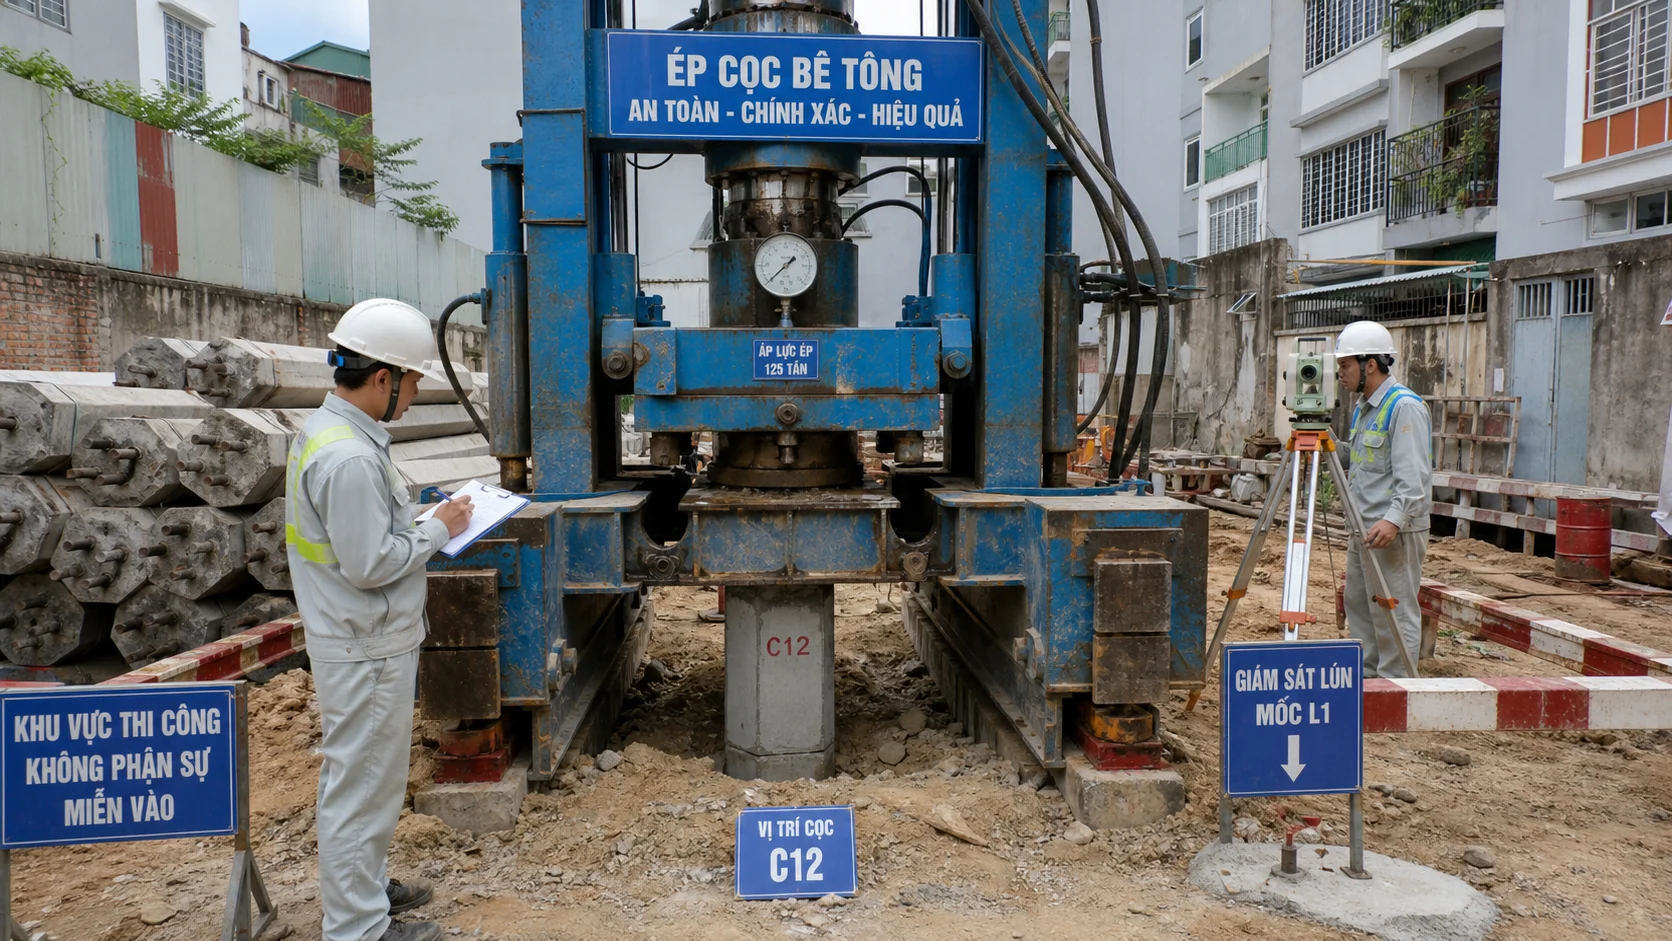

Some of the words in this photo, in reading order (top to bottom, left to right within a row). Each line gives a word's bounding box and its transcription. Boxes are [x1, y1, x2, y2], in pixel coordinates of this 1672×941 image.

[667, 46, 707, 87] ÉP
[718, 54, 781, 94] CỌC
[792, 50, 831, 90] BÊ
[841, 50, 922, 92] TÔNG
[628, 98, 658, 122] AN
[664, 94, 719, 124] TOÀN
[741, 96, 804, 125] CHÍNH
[810, 98, 851, 126] XÁC
[872, 102, 918, 130] HIỆU
[923, 100, 964, 129] QUẢ
[776, 343, 797, 360] LỰC
[764, 363, 784, 376] 125
[767, 635, 809, 656] C12
[1235, 664, 1279, 692] GIÁM
[1283, 663, 1316, 691] SÁT
[1320, 662, 1353, 690] LÚN
[14, 714, 60, 743] KHU
[68, 709, 112, 746] VỰC
[119, 711, 154, 738] THI
[161, 703, 221, 737] CÔNG
[1256, 695, 1302, 726] MỐC
[1309, 702, 1330, 724] L1
[26, 750, 104, 785] KHÔNG
[111, 746, 173, 785] PHẬN
[180, 746, 212, 783] SỰ
[64, 787, 123, 827] MIỄN
[130, 789, 175, 823] VÀO
[757, 820, 773, 842] VỊ
[776, 816, 800, 837] TRÍ
[804, 818, 834, 841] CỌC
[769, 846, 825, 883] C12
